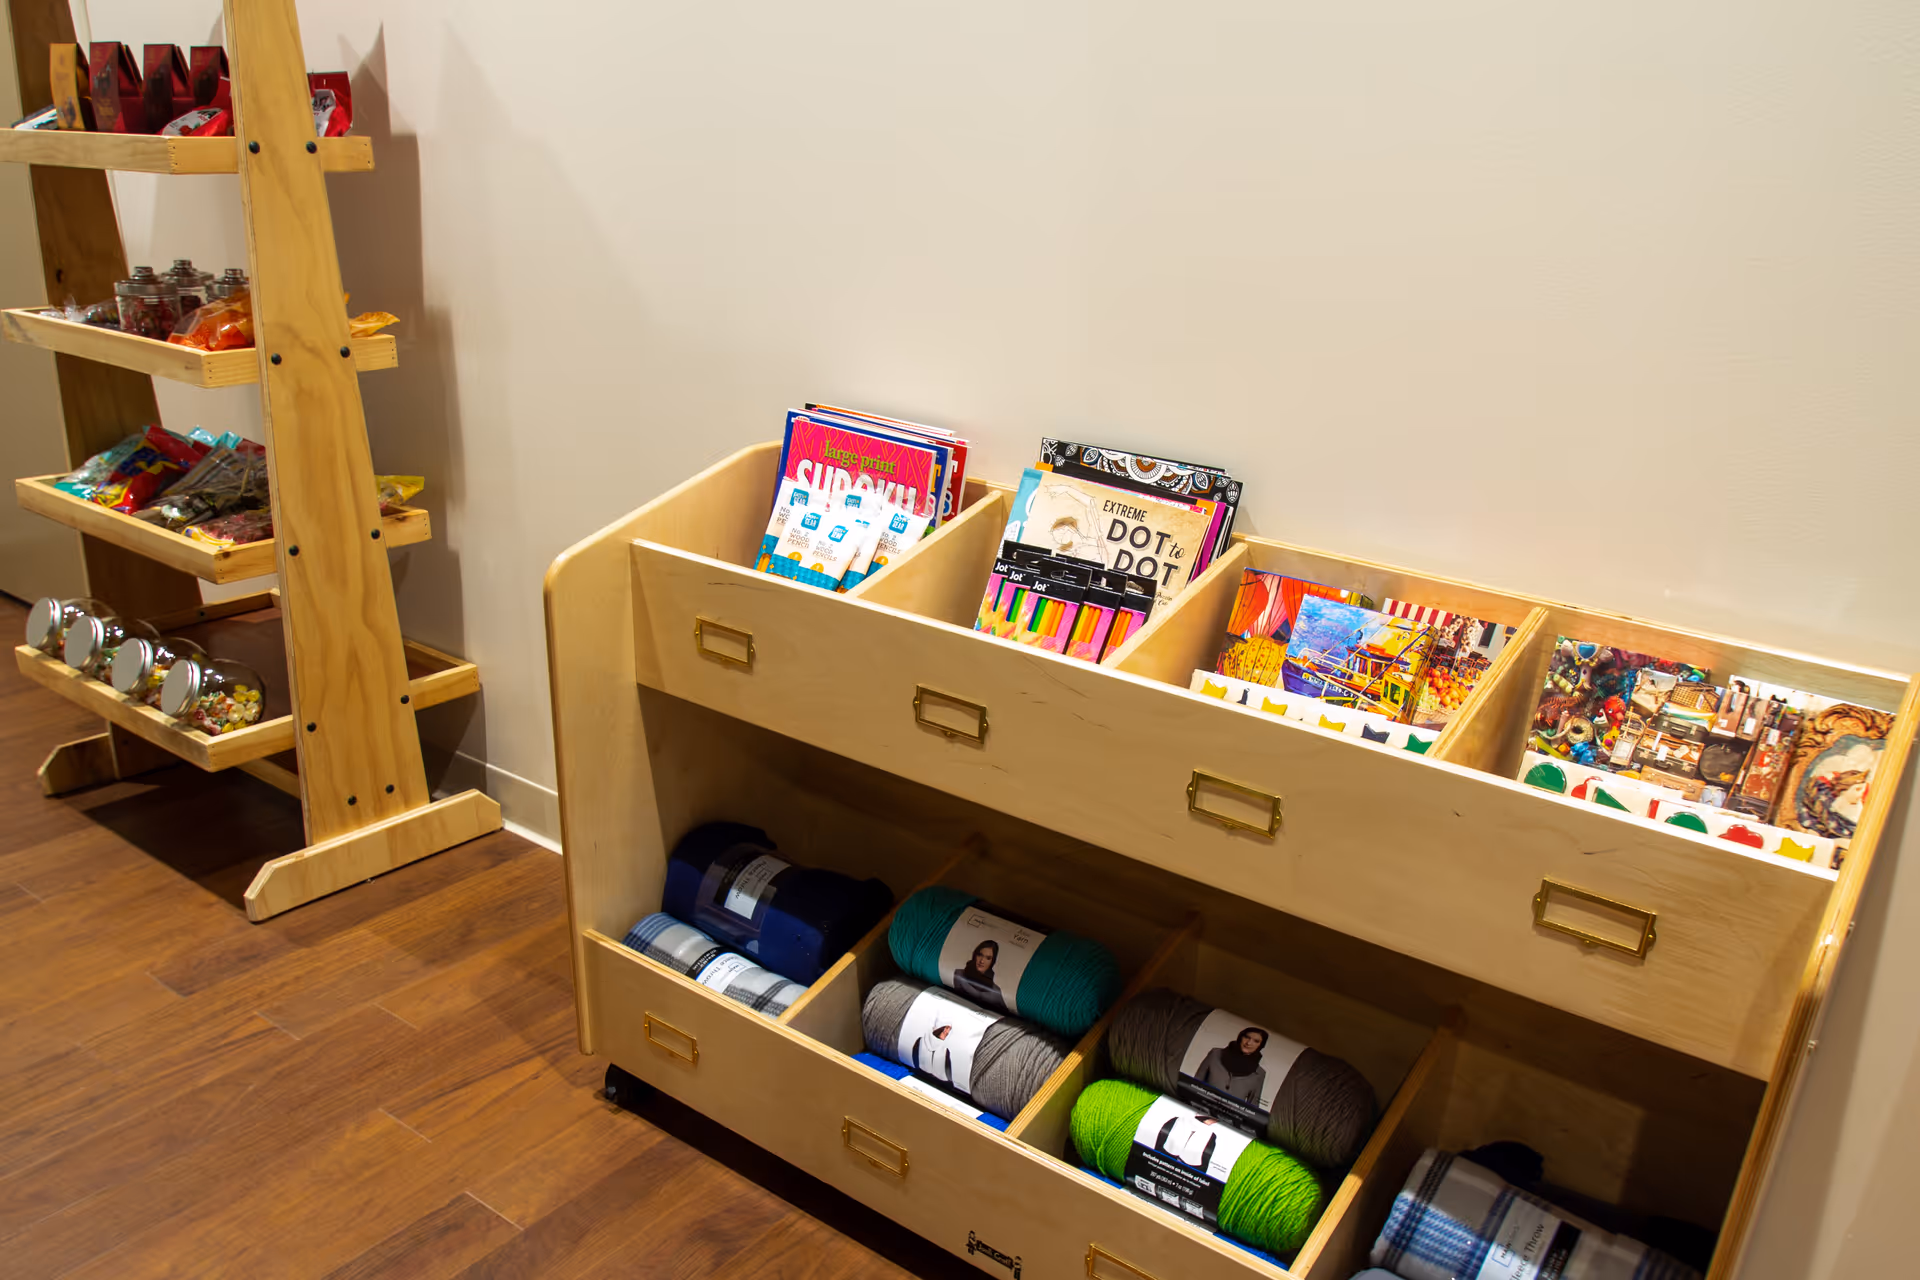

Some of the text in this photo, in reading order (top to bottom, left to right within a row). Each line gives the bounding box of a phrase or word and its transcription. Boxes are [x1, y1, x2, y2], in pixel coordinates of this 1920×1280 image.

[824, 440, 897, 475] large print
[1103, 500, 1147, 522] EXTREME
[789, 532, 810, 543] WOOD
[1106, 518, 1186, 559] DOT to
[815, 545, 834, 554] WOOD
[880, 543, 902, 555] ENCILS
[812, 550, 838, 562] PENCILS
[994, 562, 1009, 573] Jot
[1113, 548, 1179, 586] DOT
[1009, 570, 1023, 582] Jot
[1032, 580, 1047, 592] Jot
[1013, 934, 1029, 944] Yarn
[1142, 1151, 1160, 1163] Includes
[1158, 1160, 1175, 1171] pattern
[1180, 1169, 1194, 1179] inside
[1198, 1178, 1210, 1187] label
[1509, 1223, 1545, 1280] leece Throw
